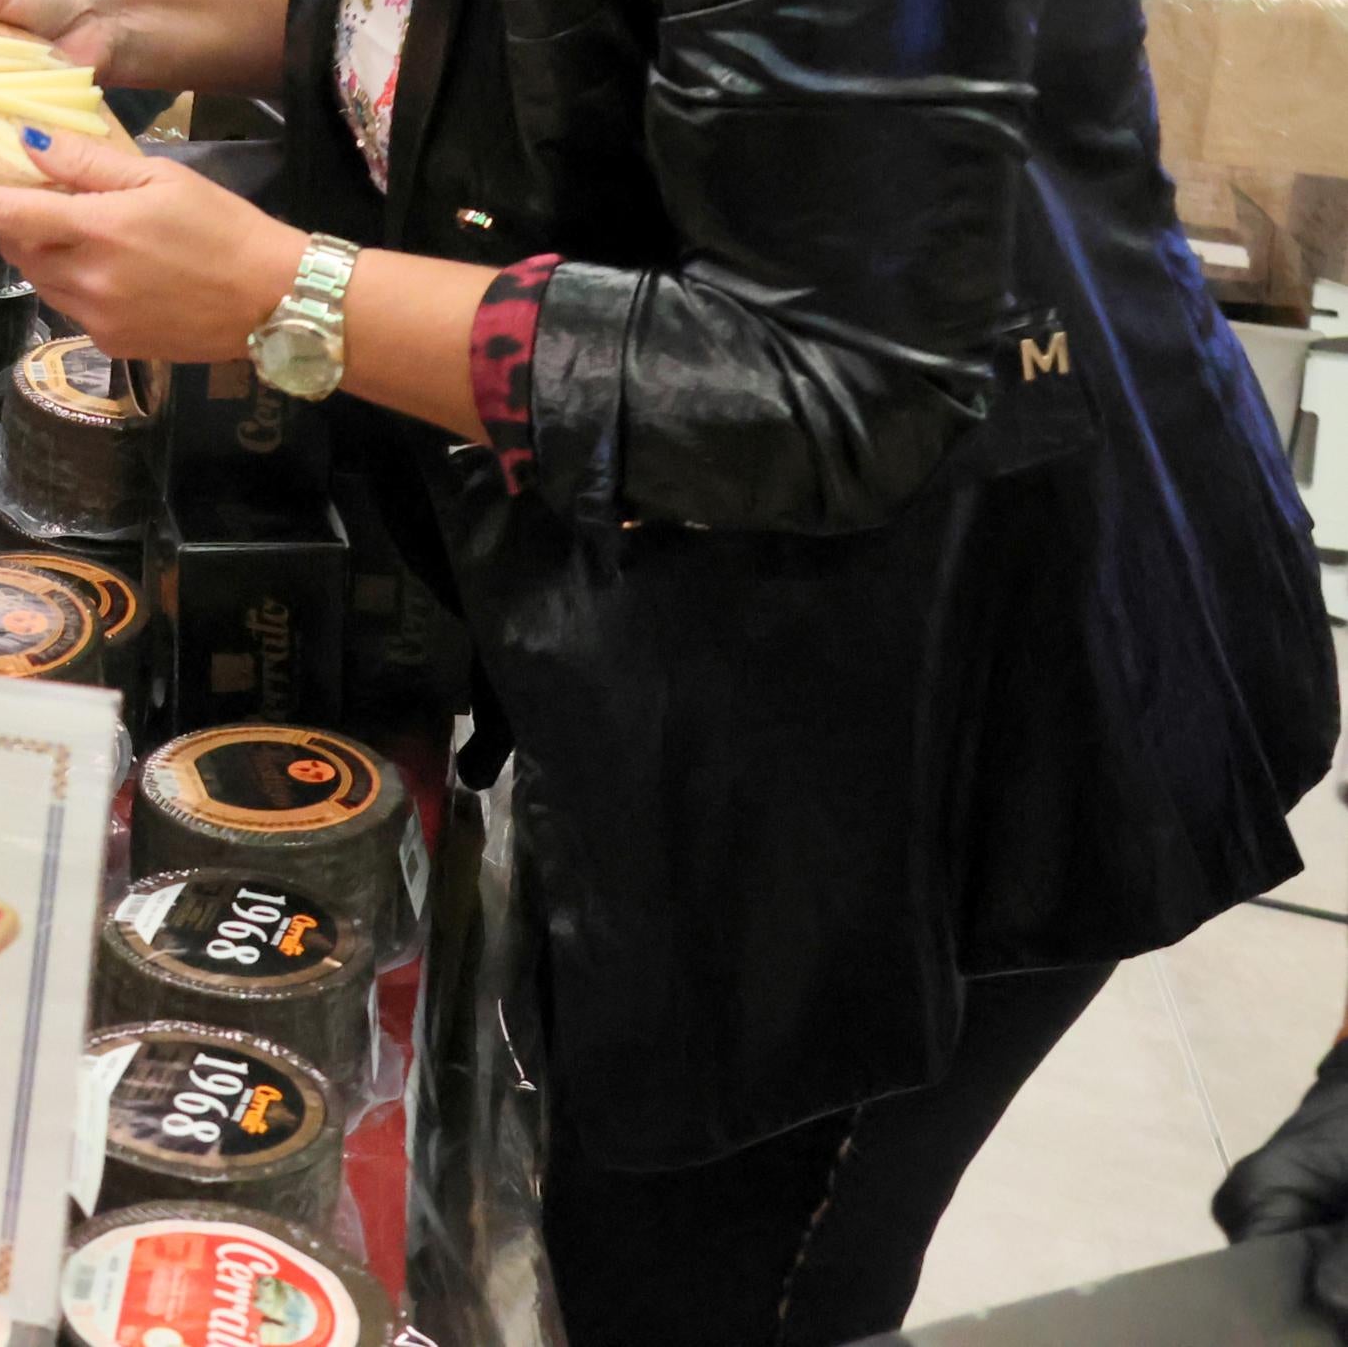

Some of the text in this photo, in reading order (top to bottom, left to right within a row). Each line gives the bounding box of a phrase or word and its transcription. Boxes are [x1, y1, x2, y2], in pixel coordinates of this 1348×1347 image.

[1019, 331, 1071, 382] M
[206, 887, 286, 965] 1968
[162, 1052, 249, 1143] 1968
[206, 1242, 280, 1347] Cerrat
